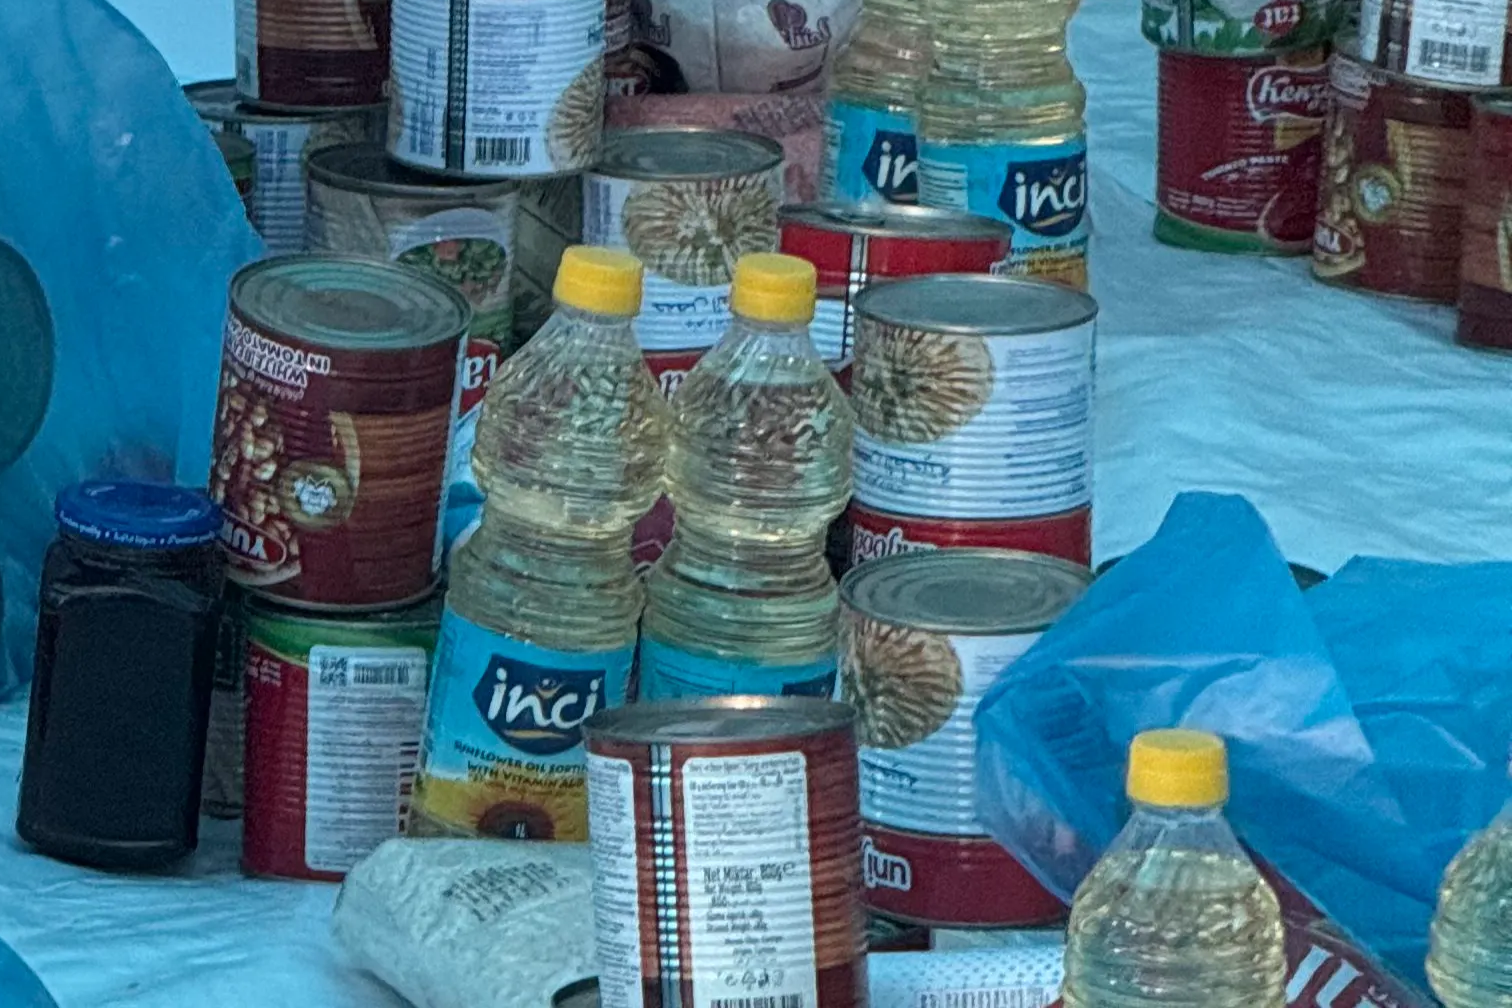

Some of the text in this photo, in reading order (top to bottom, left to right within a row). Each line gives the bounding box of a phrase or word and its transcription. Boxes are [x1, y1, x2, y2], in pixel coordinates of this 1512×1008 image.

[307, 353, 331, 375] IN
[488, 667, 601, 730] inci
[467, 761, 500, 779] WITH
[503, 770, 558, 789] VITAMIN
[527, 760, 547, 773] OIL
